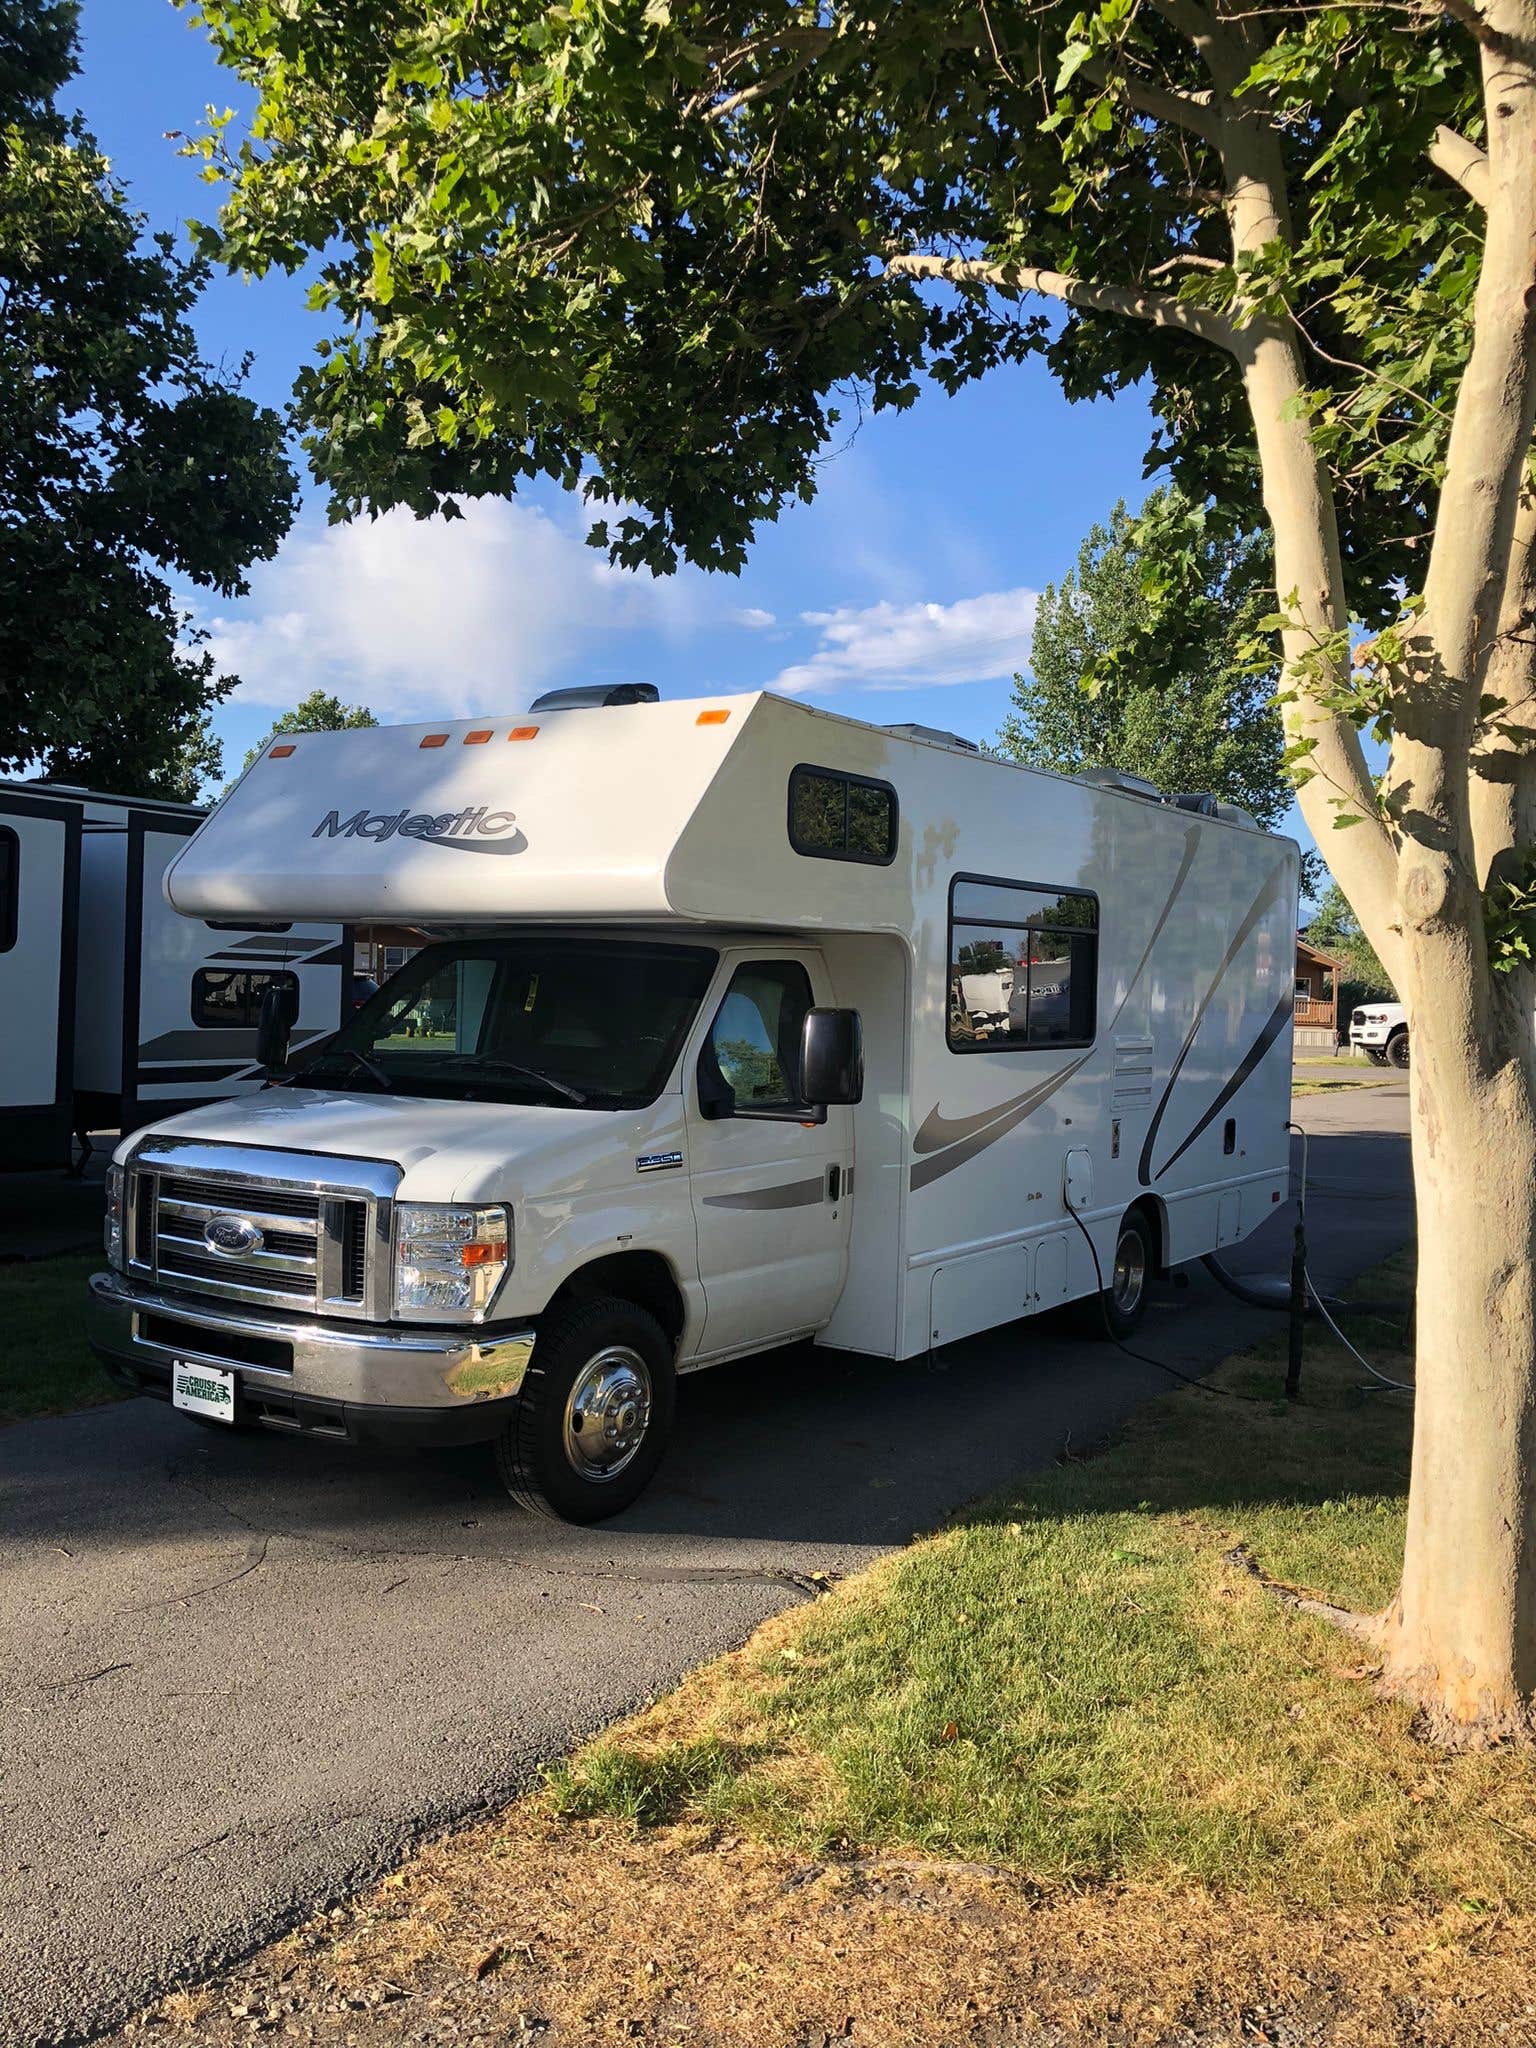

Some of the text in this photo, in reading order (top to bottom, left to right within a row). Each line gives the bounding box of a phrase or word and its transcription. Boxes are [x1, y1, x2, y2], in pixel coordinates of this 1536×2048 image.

[312, 806, 517, 843] Majestic
[213, 1226, 240, 1245] Ford
[188, 1376, 217, 1391] CRUISE
[185, 1385, 221, 1403] AMERICA
